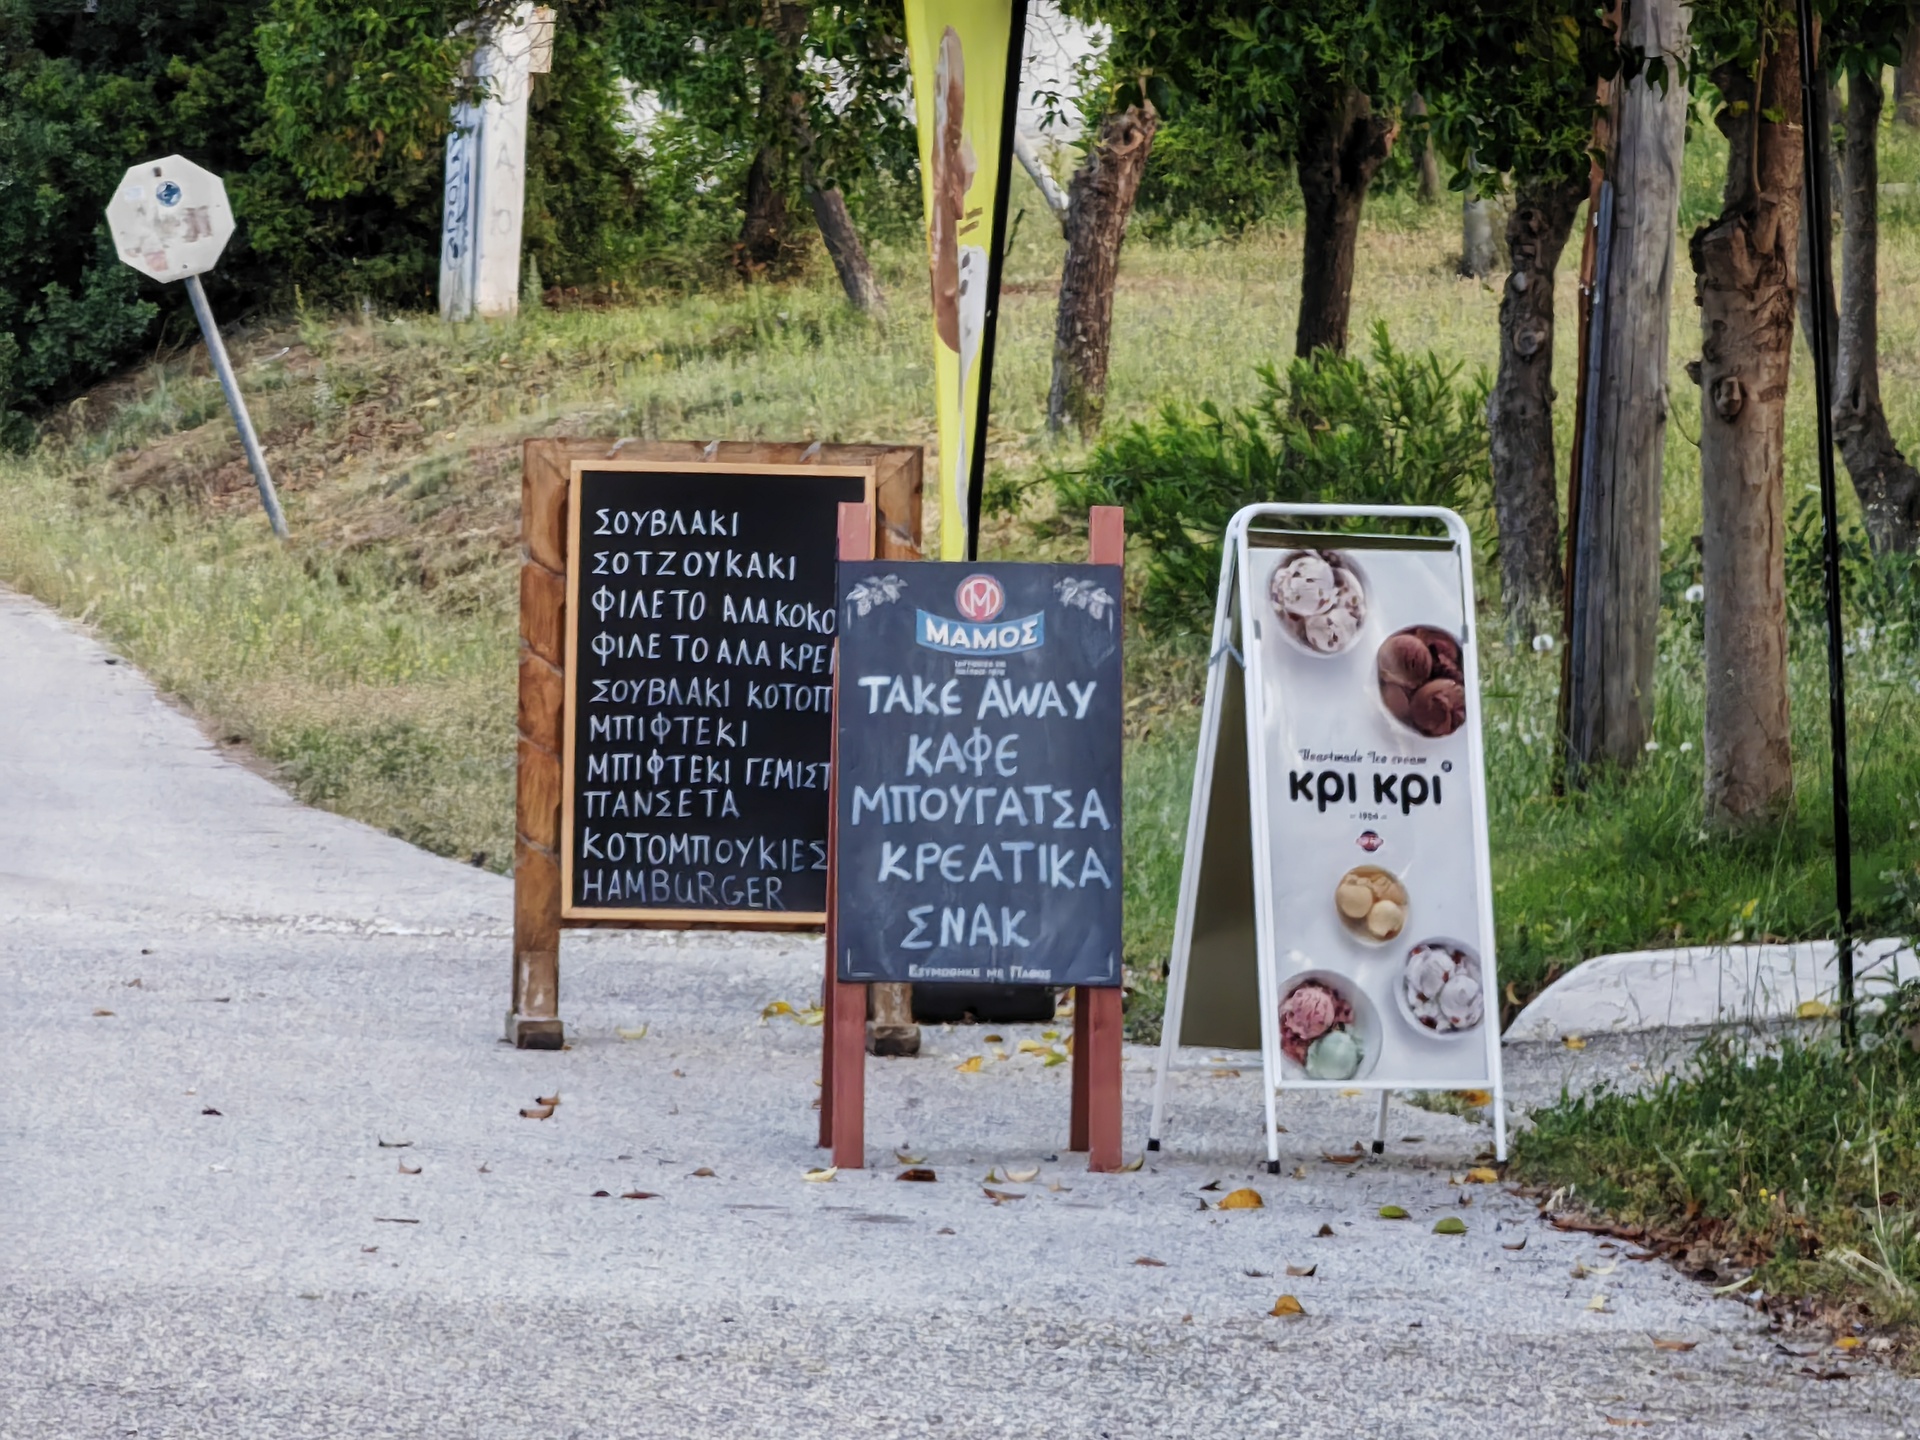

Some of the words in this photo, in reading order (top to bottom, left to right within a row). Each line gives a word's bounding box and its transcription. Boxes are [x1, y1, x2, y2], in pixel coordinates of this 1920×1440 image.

[593, 508, 740, 537] ΣΟΥΒΛΑΚΙ
[591, 549, 796, 580] ΣΟΤΖΟΥΚΑΚΙ
[925, 616, 1039, 650] ΜΑΜΟΣ
[589, 677, 730, 708] ΣΟΥΒΛΑΚΙ
[858, 675, 962, 715] TAKE
[976, 677, 1097, 720] AWAY
[589, 711, 748, 747] ΜΠΙΦΤΕΚΙ
[587, 748, 730, 785] ΜΠΙΦΤΕΚΙ
[905, 726, 1019, 778] ΚΑΦΕ
[583, 788, 741, 819] ΠΑΝΣΕΤΑ
[851, 783, 1112, 831] ΜΠΟΥΓΑΤΣΑ
[877, 841, 1112, 890] ΚΡΕΑΤΙΚΑ
[582, 868, 786, 910] HAMBURGER
[900, 902, 1031, 949] ΣΝΑΚ
